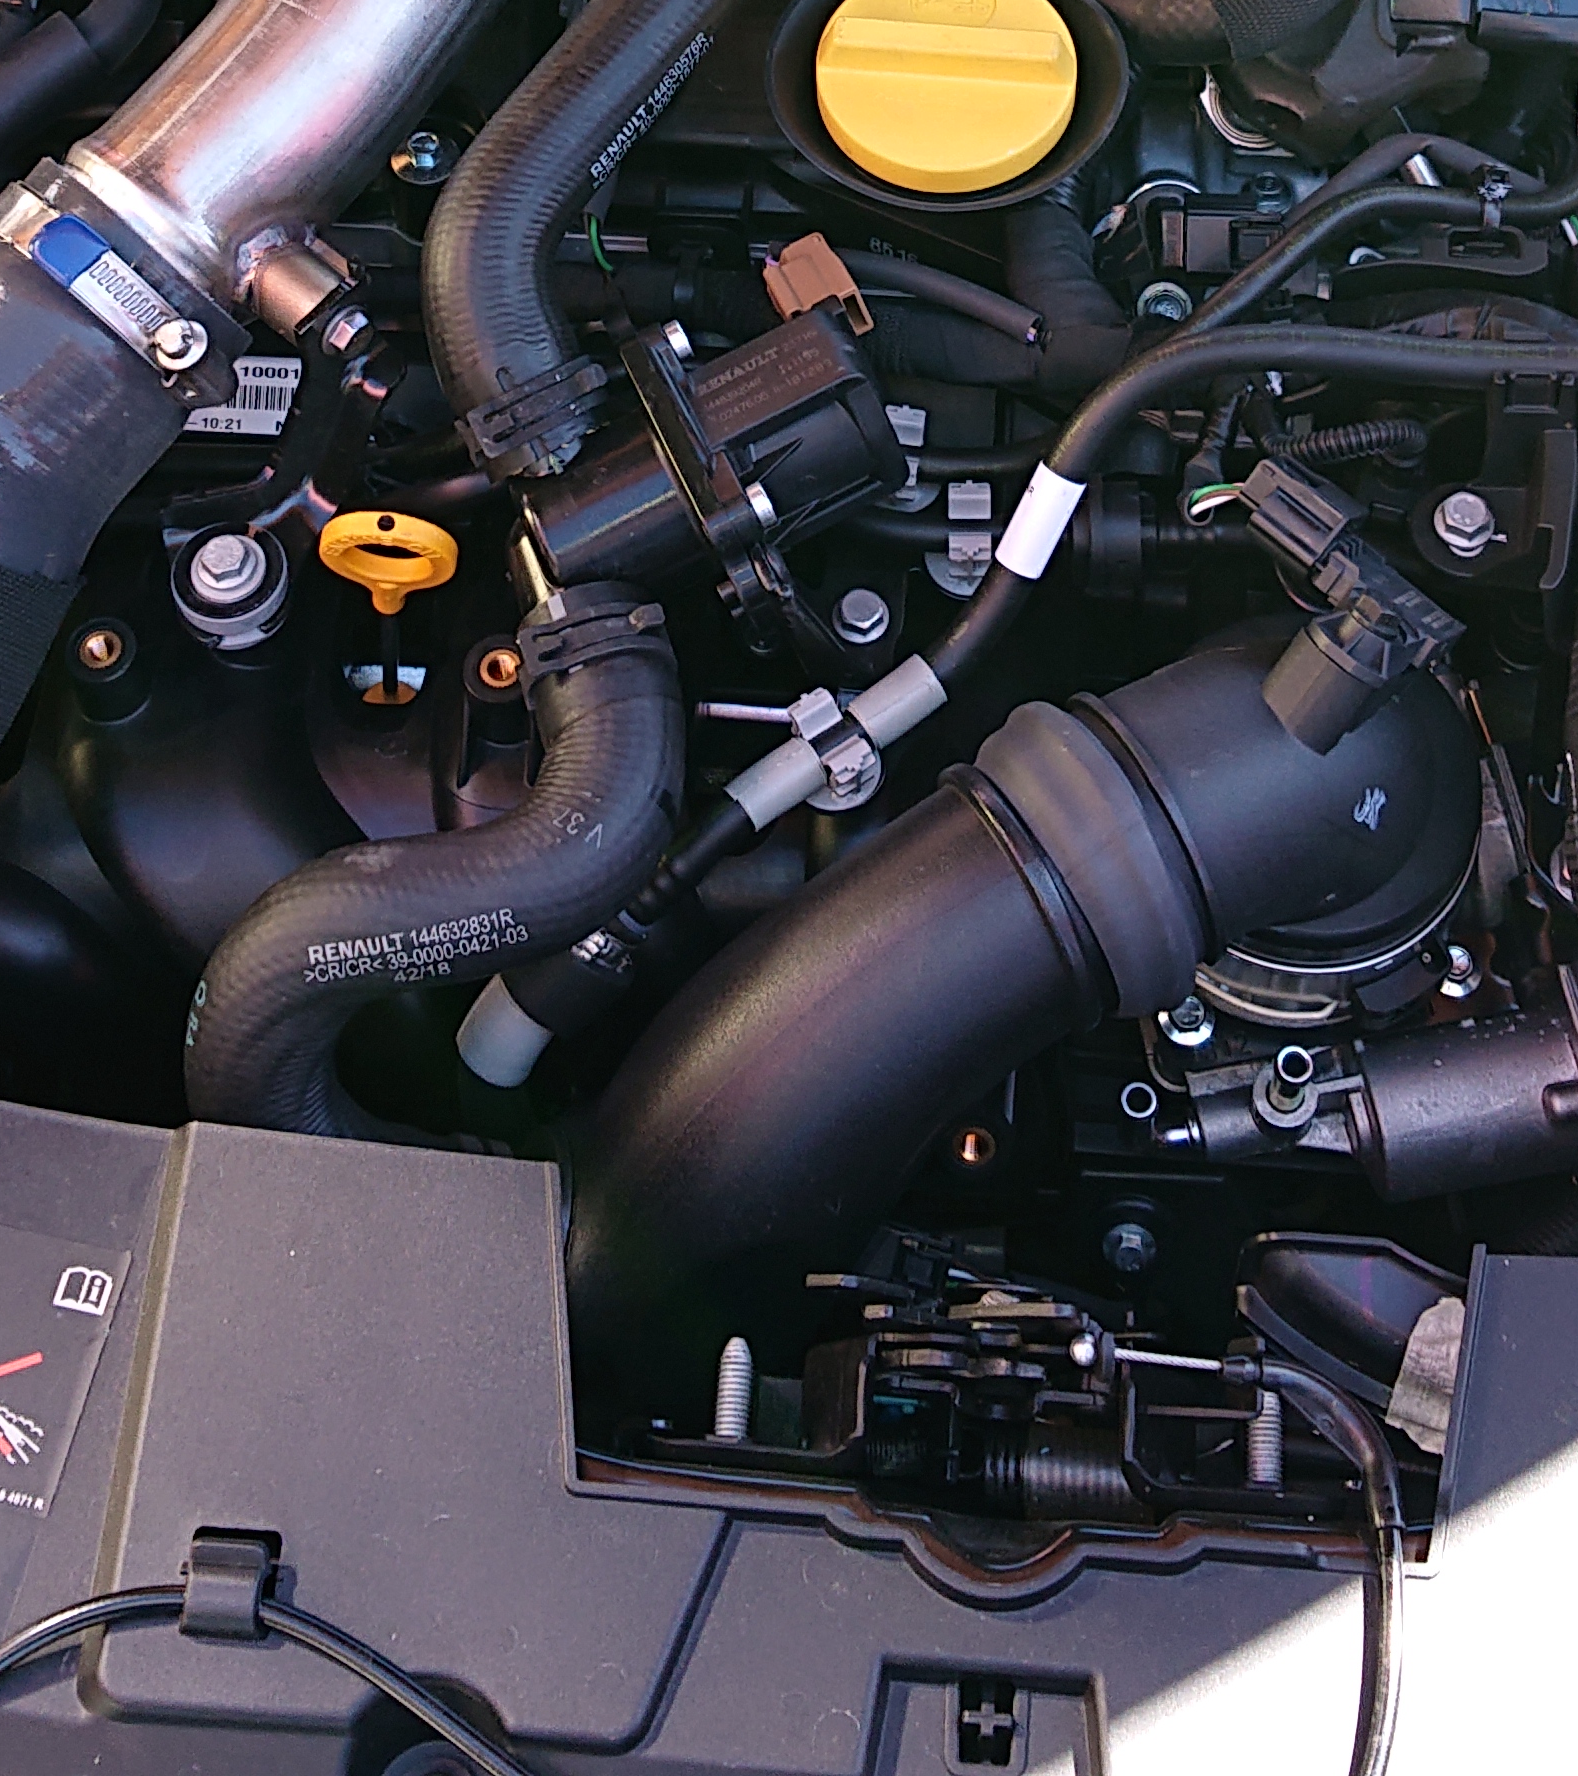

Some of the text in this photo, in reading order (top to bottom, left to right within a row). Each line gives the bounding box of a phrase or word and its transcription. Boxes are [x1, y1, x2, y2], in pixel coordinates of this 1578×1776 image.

[589, 30, 709, 178] RENAULT 144630576R
[238, 364, 302, 382] 10001
[697, 346, 779, 397] RENAULT
[200, 416, 243, 432] 10:21
[307, 906, 516, 966] RENAULT 144632831R
[385, 924, 531, 972] 39-0000-0421-03
[393, 960, 453, 984] 42/18
